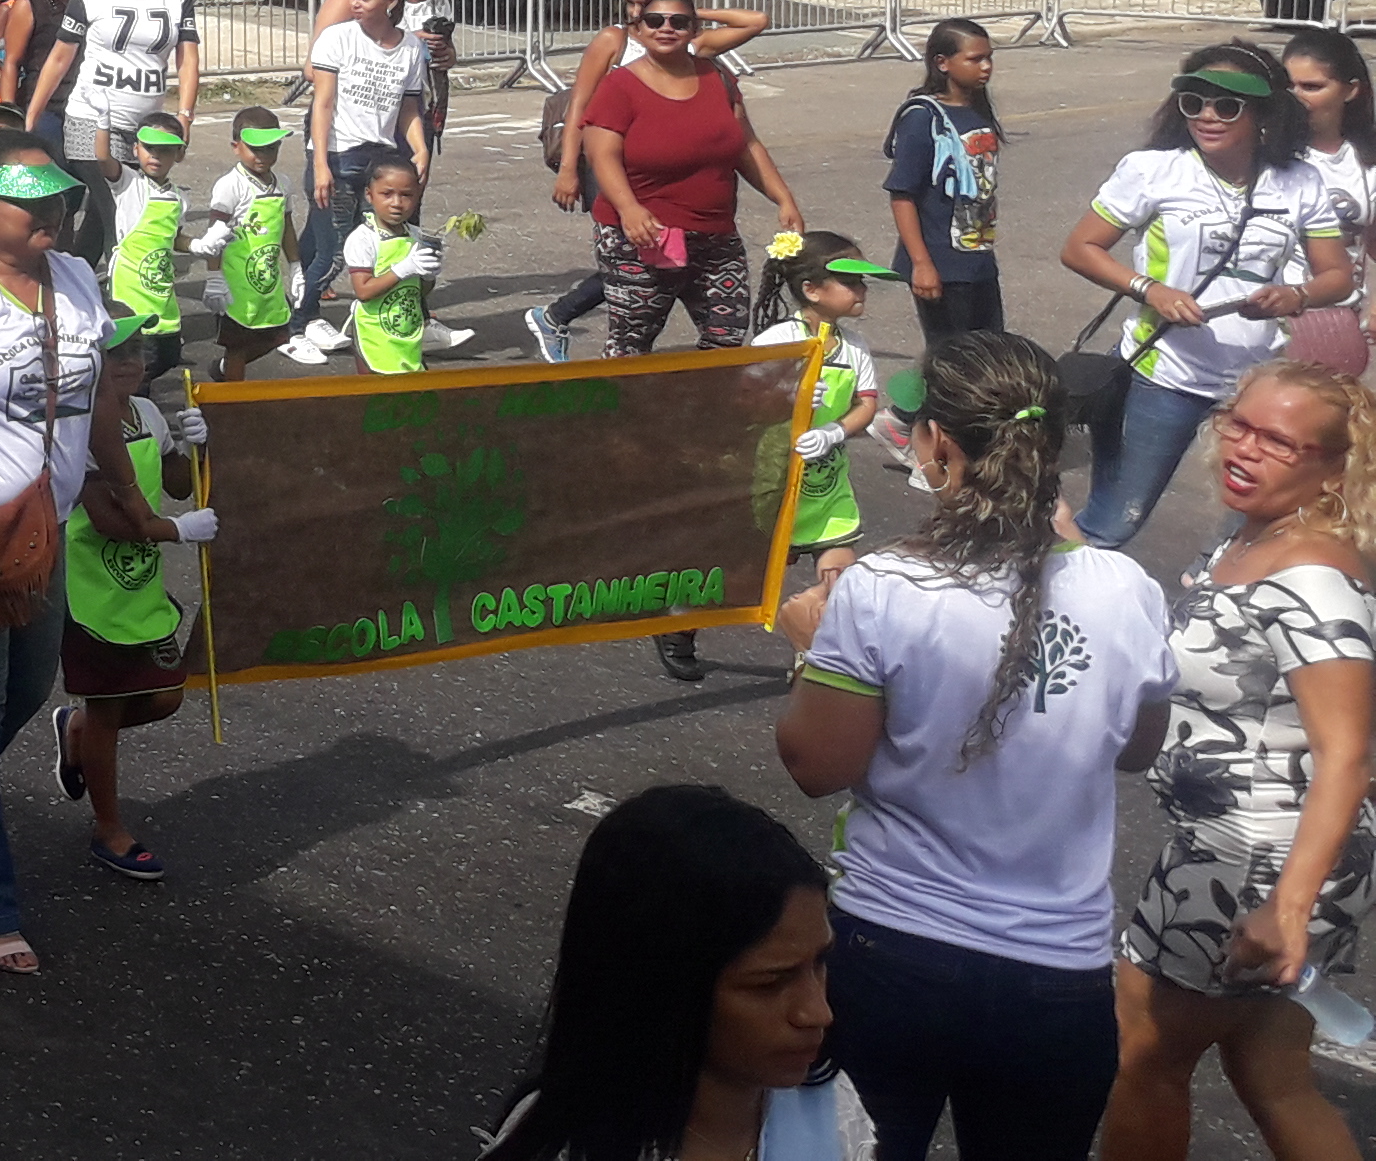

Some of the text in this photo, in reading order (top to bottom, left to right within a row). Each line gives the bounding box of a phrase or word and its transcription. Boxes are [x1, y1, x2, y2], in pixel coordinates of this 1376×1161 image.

[112, 6, 172, 54] 77
[262, 565, 726, 664] ESCOLA CASTANHEIRA
